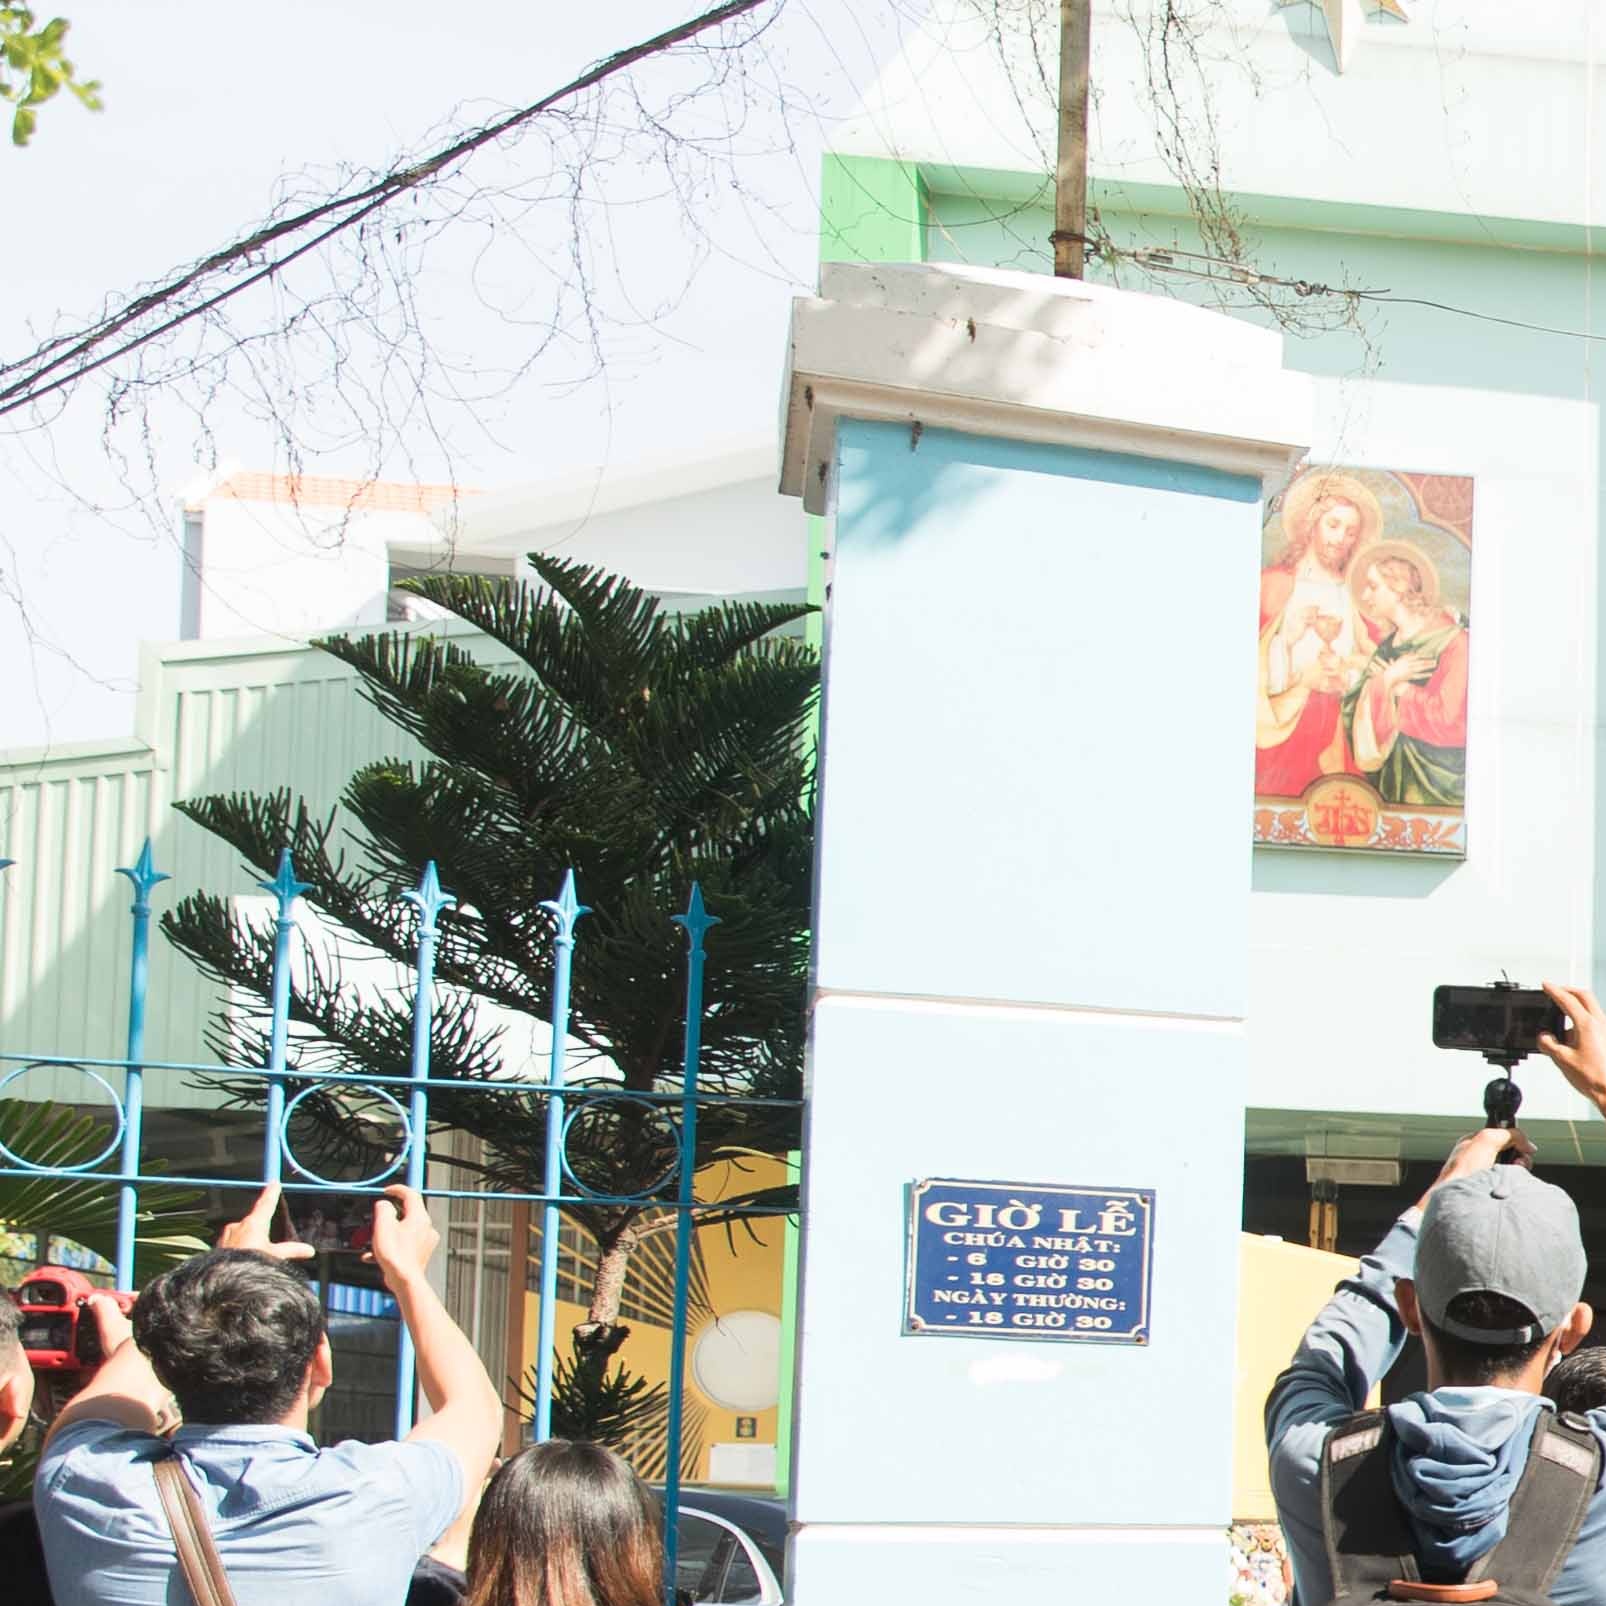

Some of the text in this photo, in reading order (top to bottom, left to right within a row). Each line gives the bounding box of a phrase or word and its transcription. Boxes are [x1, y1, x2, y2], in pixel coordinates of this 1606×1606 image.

[925, 1199, 1137, 1236] GIỜ LỄ
[943, 1231, 1121, 1253] CHÚA NHẬT:
[966, 1252, 988, 1266] 6
[1015, 1253, 1070, 1270] GIỜ
[1078, 1257, 1116, 1273] 30
[969, 1272, 1006, 1286] 18
[1013, 1273, 1068, 1289] GIỜ
[1076, 1276, 1114, 1291] 30
[933, 1288, 1127, 1311] NGÀY THƯỜNG:
[968, 1310, 1004, 1325] 18
[1011, 1312, 1066, 1328] GIỜ
[1075, 1315, 1113, 1329] 30
